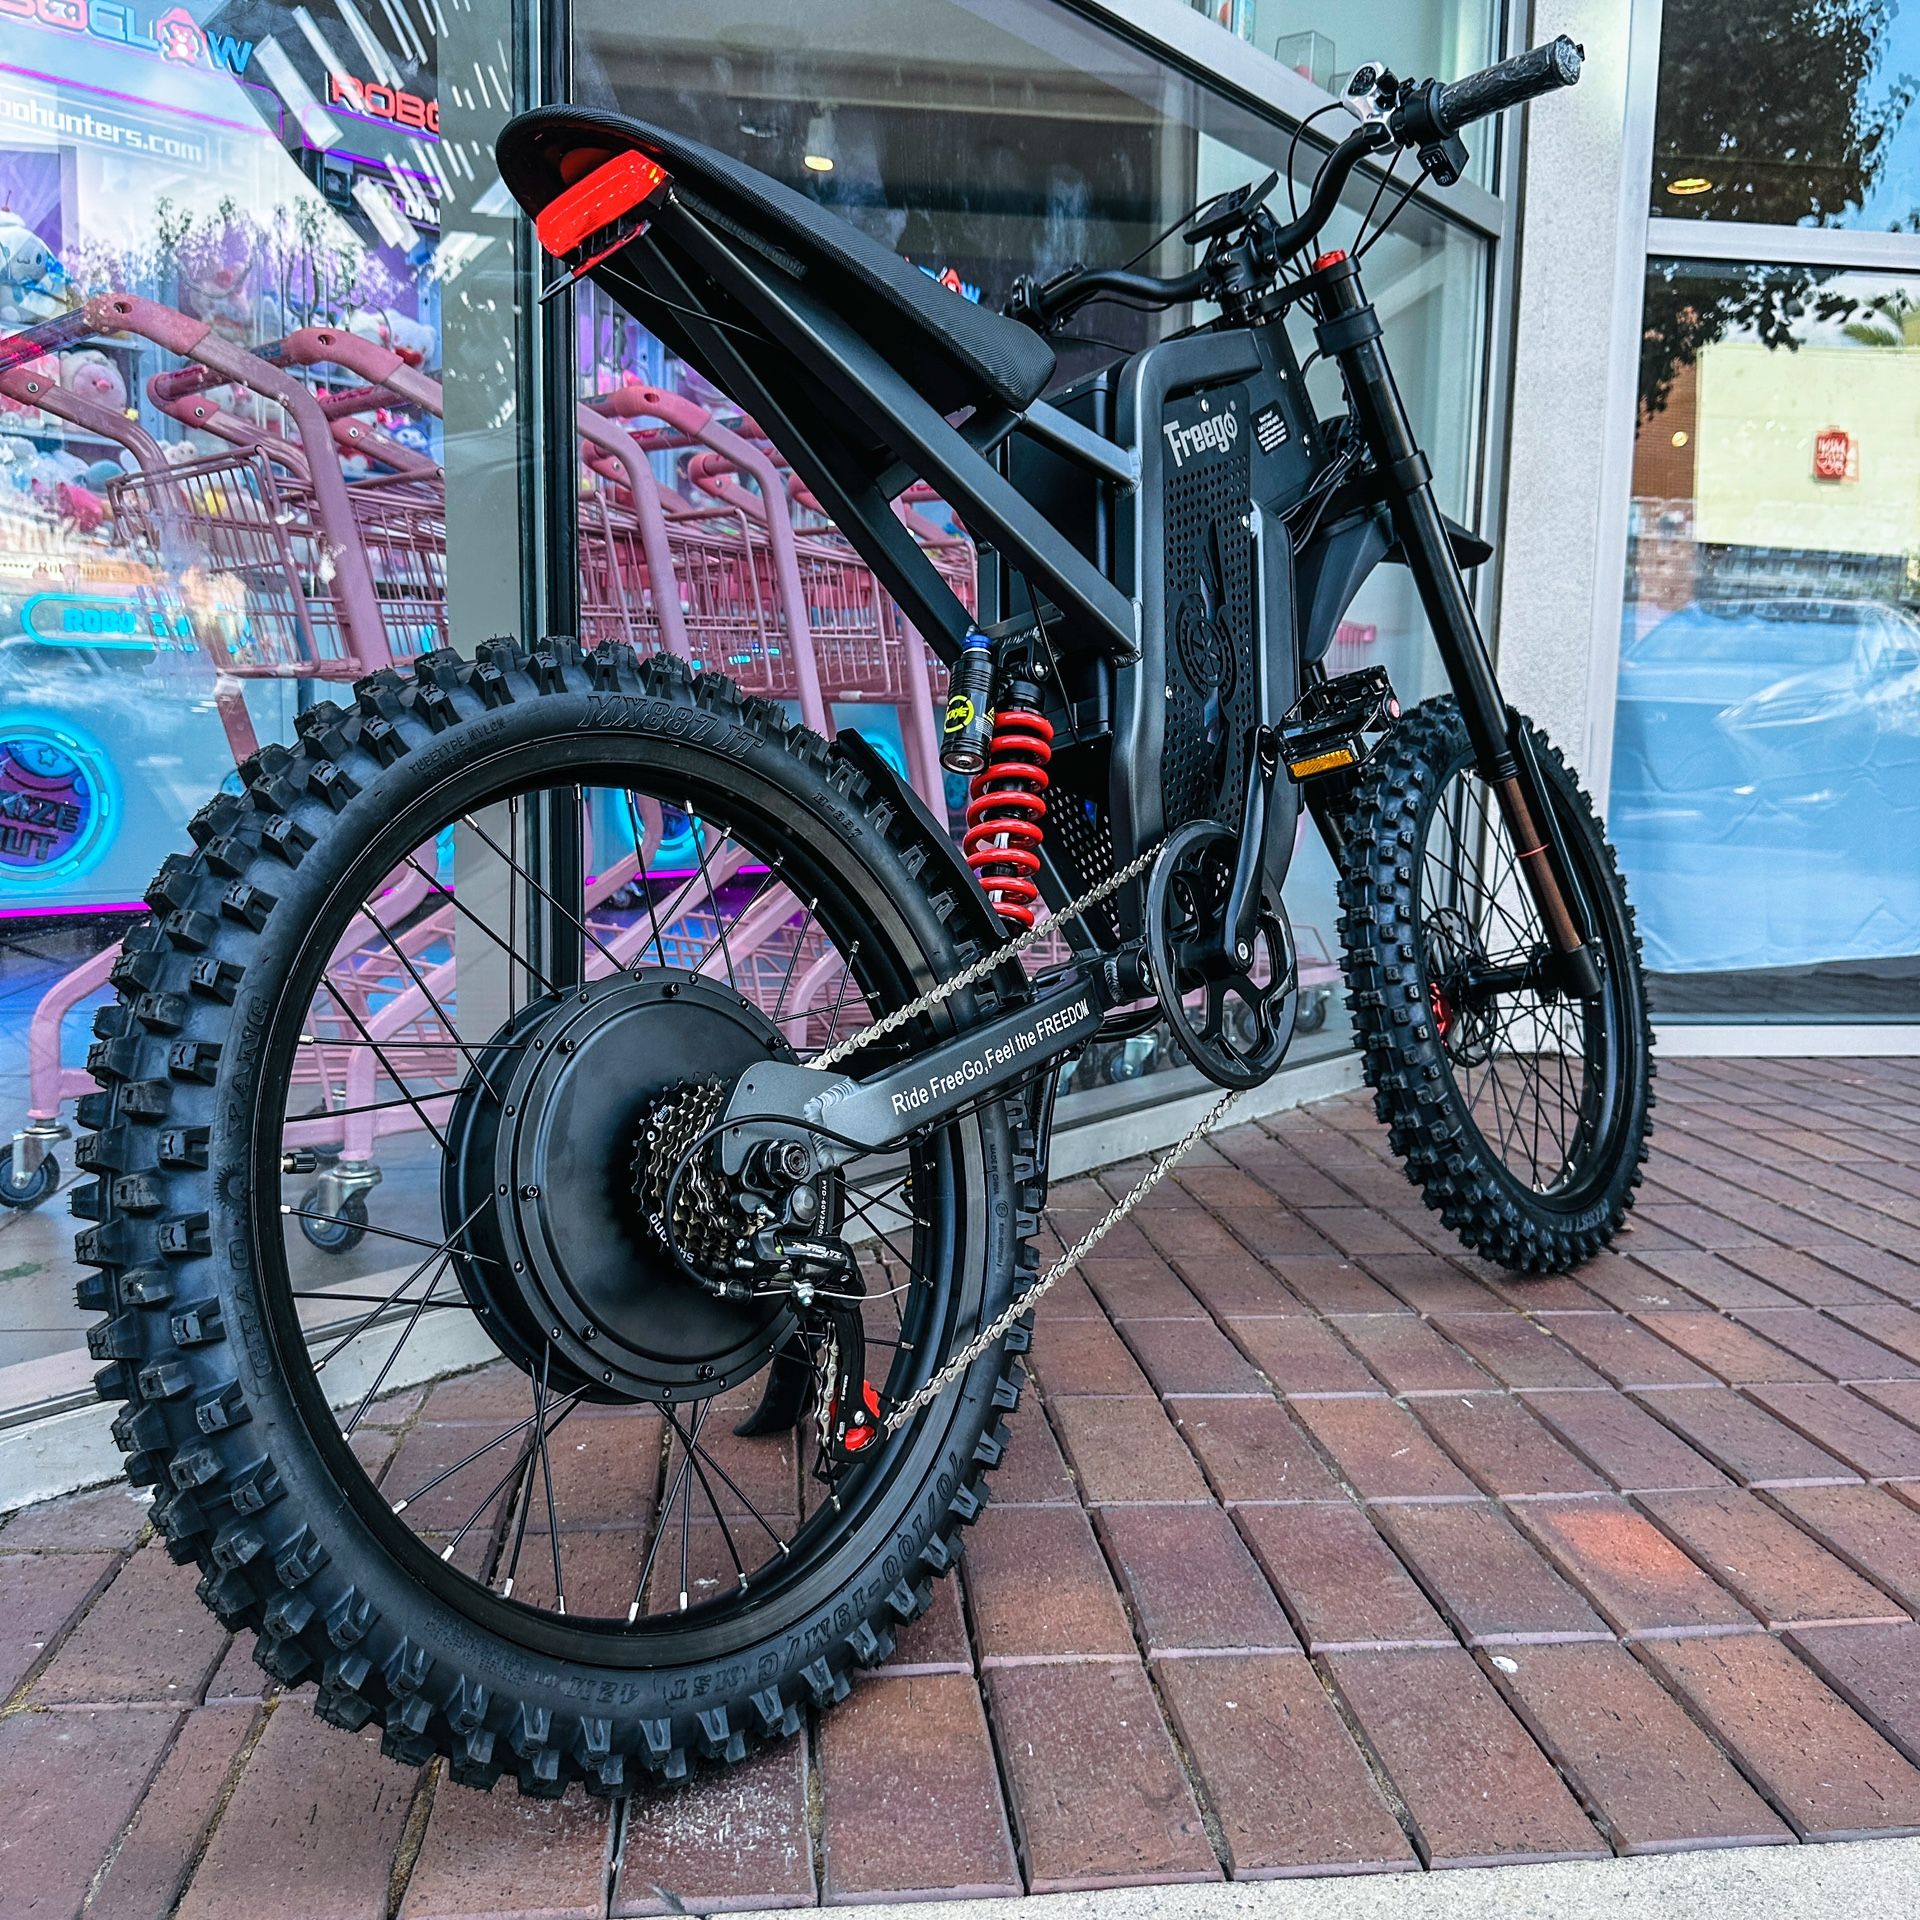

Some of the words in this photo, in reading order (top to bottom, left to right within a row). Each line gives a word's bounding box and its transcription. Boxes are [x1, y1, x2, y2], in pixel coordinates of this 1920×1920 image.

[577, 695, 719, 742] MX887
[713, 723, 766, 758] IT
[0, 824, 59, 862] UT
[226, 996, 269, 1137] YANG
[891, 1087, 930, 1116] Ride
[1015, 1030, 1037, 1052] the
[1036, 997, 1090, 1042] FREEDOM
[817, 1180, 828, 1237] PYD-60V3000
[228, 1237, 274, 1379] CHAO
